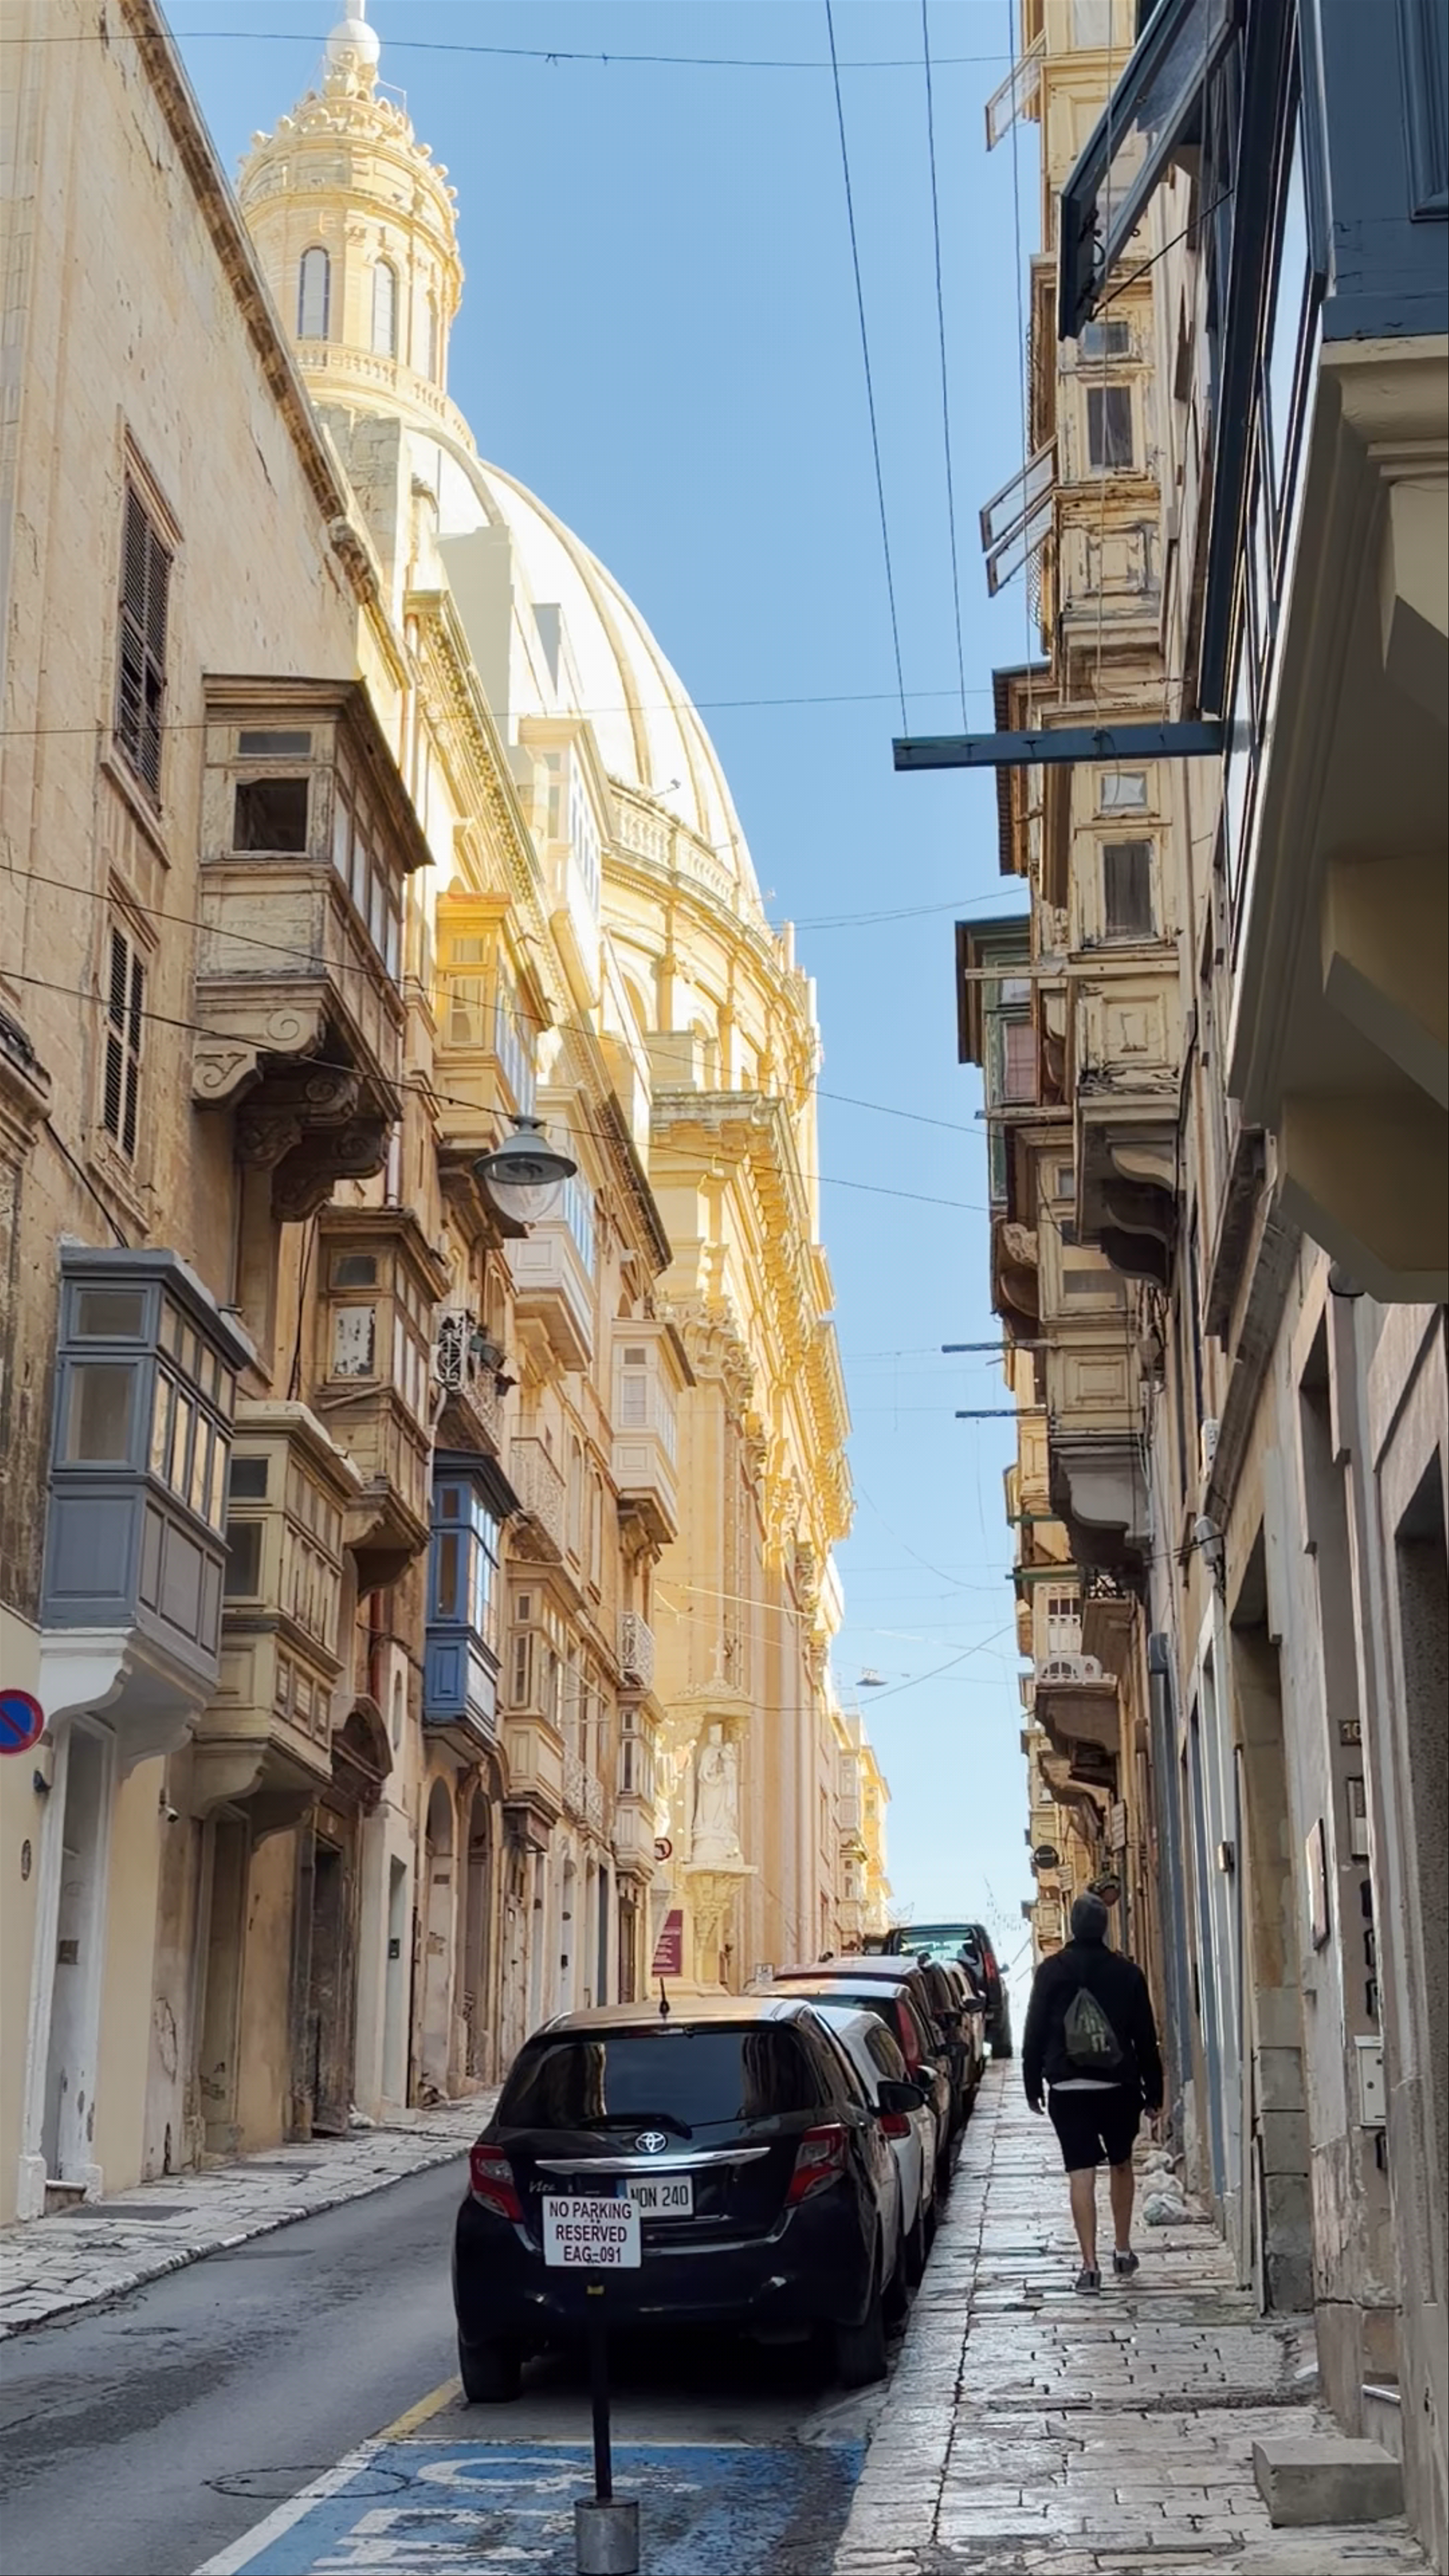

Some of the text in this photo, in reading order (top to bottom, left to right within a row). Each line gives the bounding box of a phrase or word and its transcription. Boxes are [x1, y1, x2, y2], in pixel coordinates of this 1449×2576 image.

[662, 2185, 688, 2207] 240
[550, 2201, 632, 2219] NO PARKING
[556, 2225, 627, 2242] RESERVED
[564, 2246, 621, 2263] EAG-091
